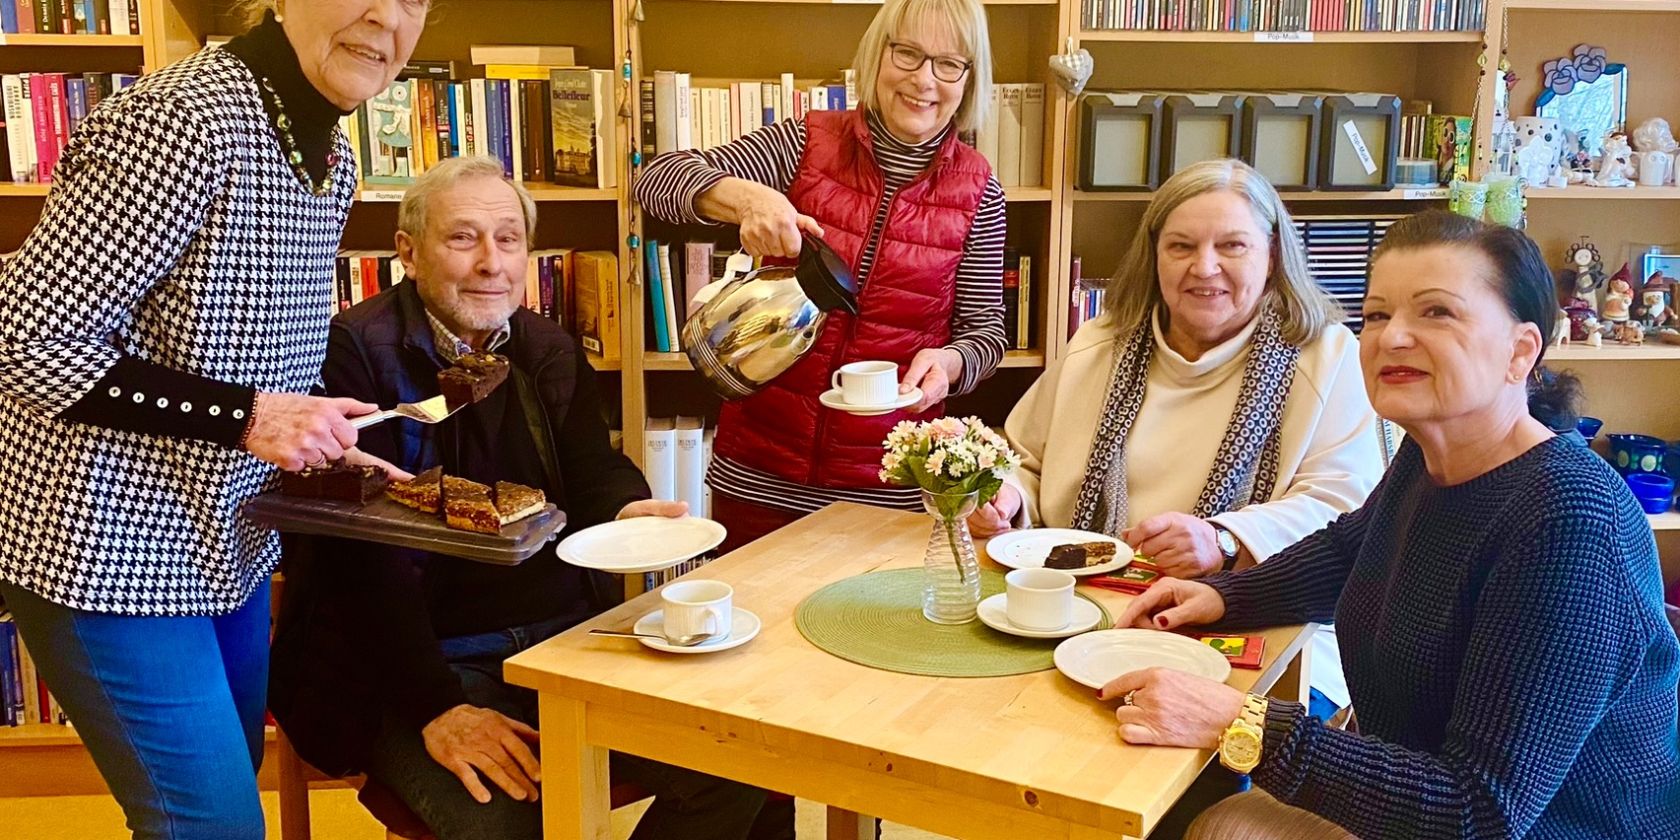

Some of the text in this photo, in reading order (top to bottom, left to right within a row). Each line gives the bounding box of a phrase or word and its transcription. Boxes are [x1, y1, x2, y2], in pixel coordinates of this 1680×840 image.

[1267, 32, 1300, 41] Pop-Musik
[22, 79, 31, 98] PIPER
[552, 89, 591, 101] Bellefleur
[1352, 132, 1369, 162] Pop-Musik
[1415, 190, 1446, 198] Pop-Musik
